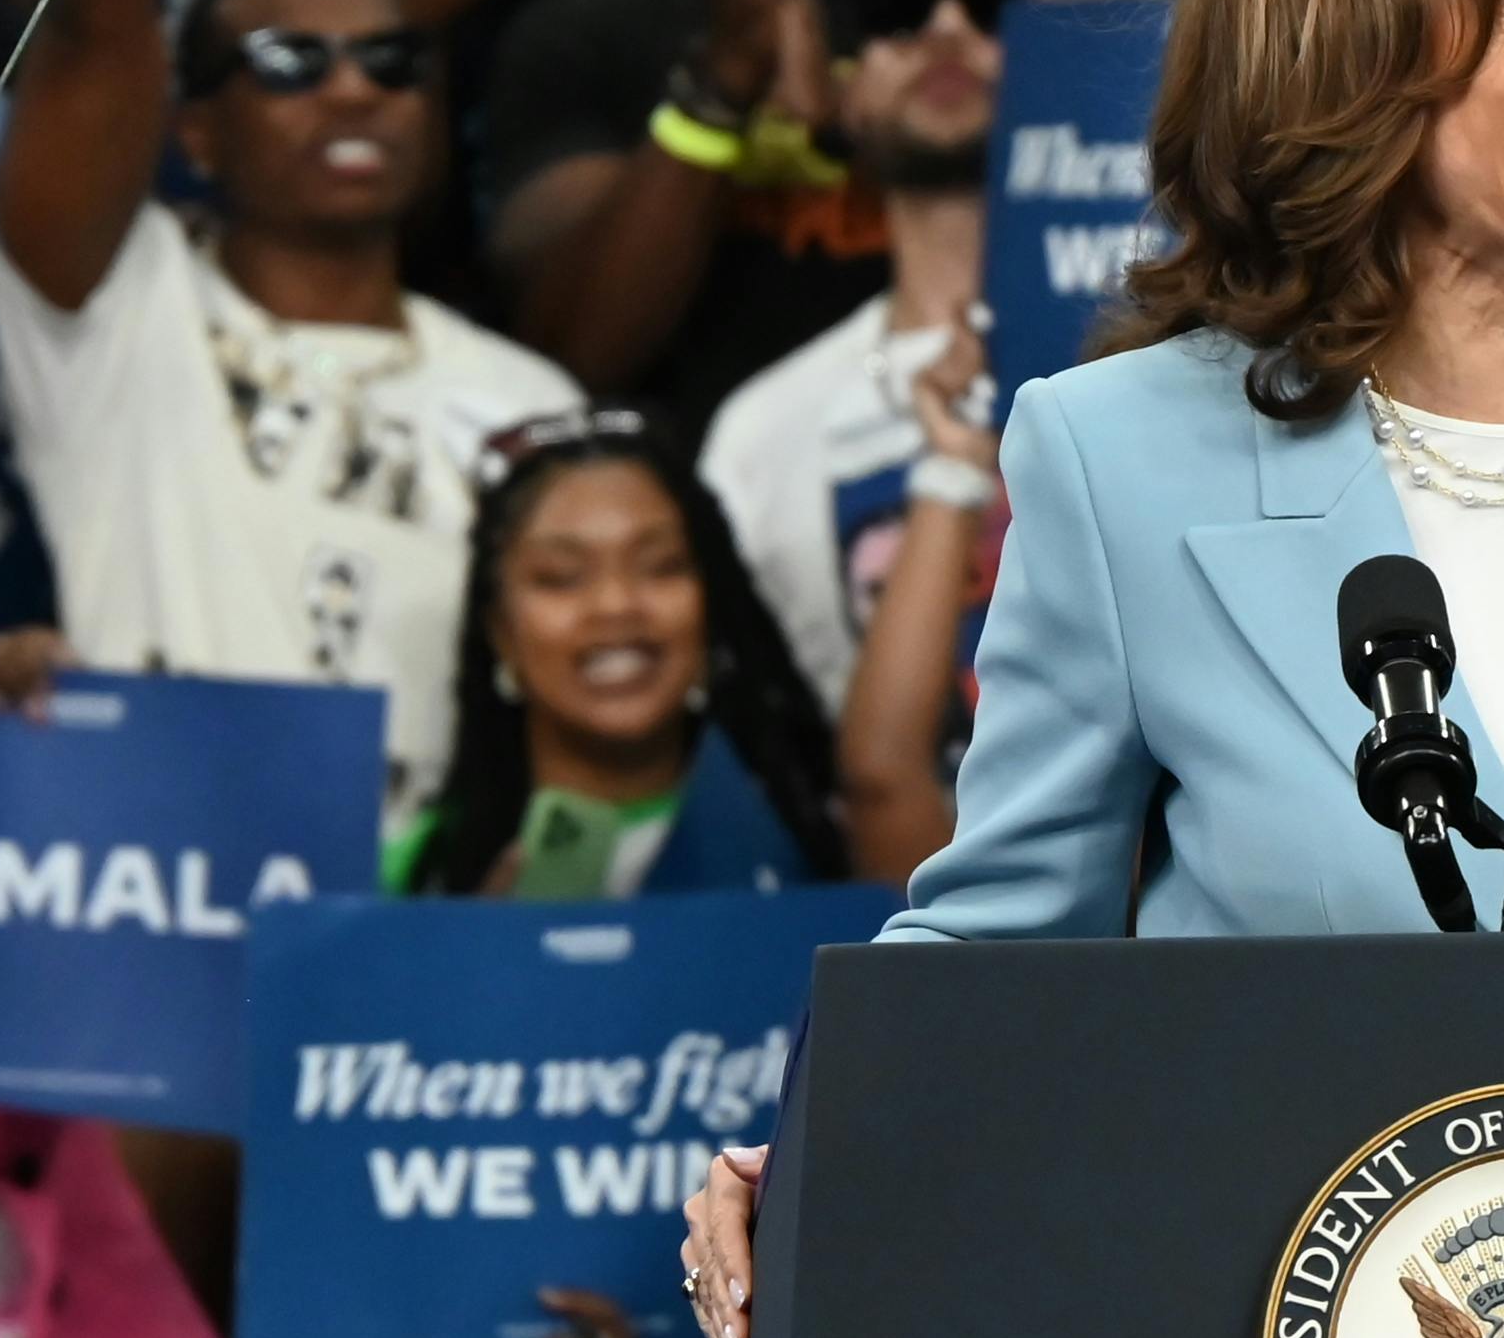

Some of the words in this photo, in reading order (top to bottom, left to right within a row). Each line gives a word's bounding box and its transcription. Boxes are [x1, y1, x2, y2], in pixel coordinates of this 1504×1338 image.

[295, 1040, 524, 1120] When
[536, 1059, 646, 1118] we
[1443, 1110, 1504, 1156] OF
[369, 1147, 534, 1219] WE
[1472, 1292, 1487, 1308] E
